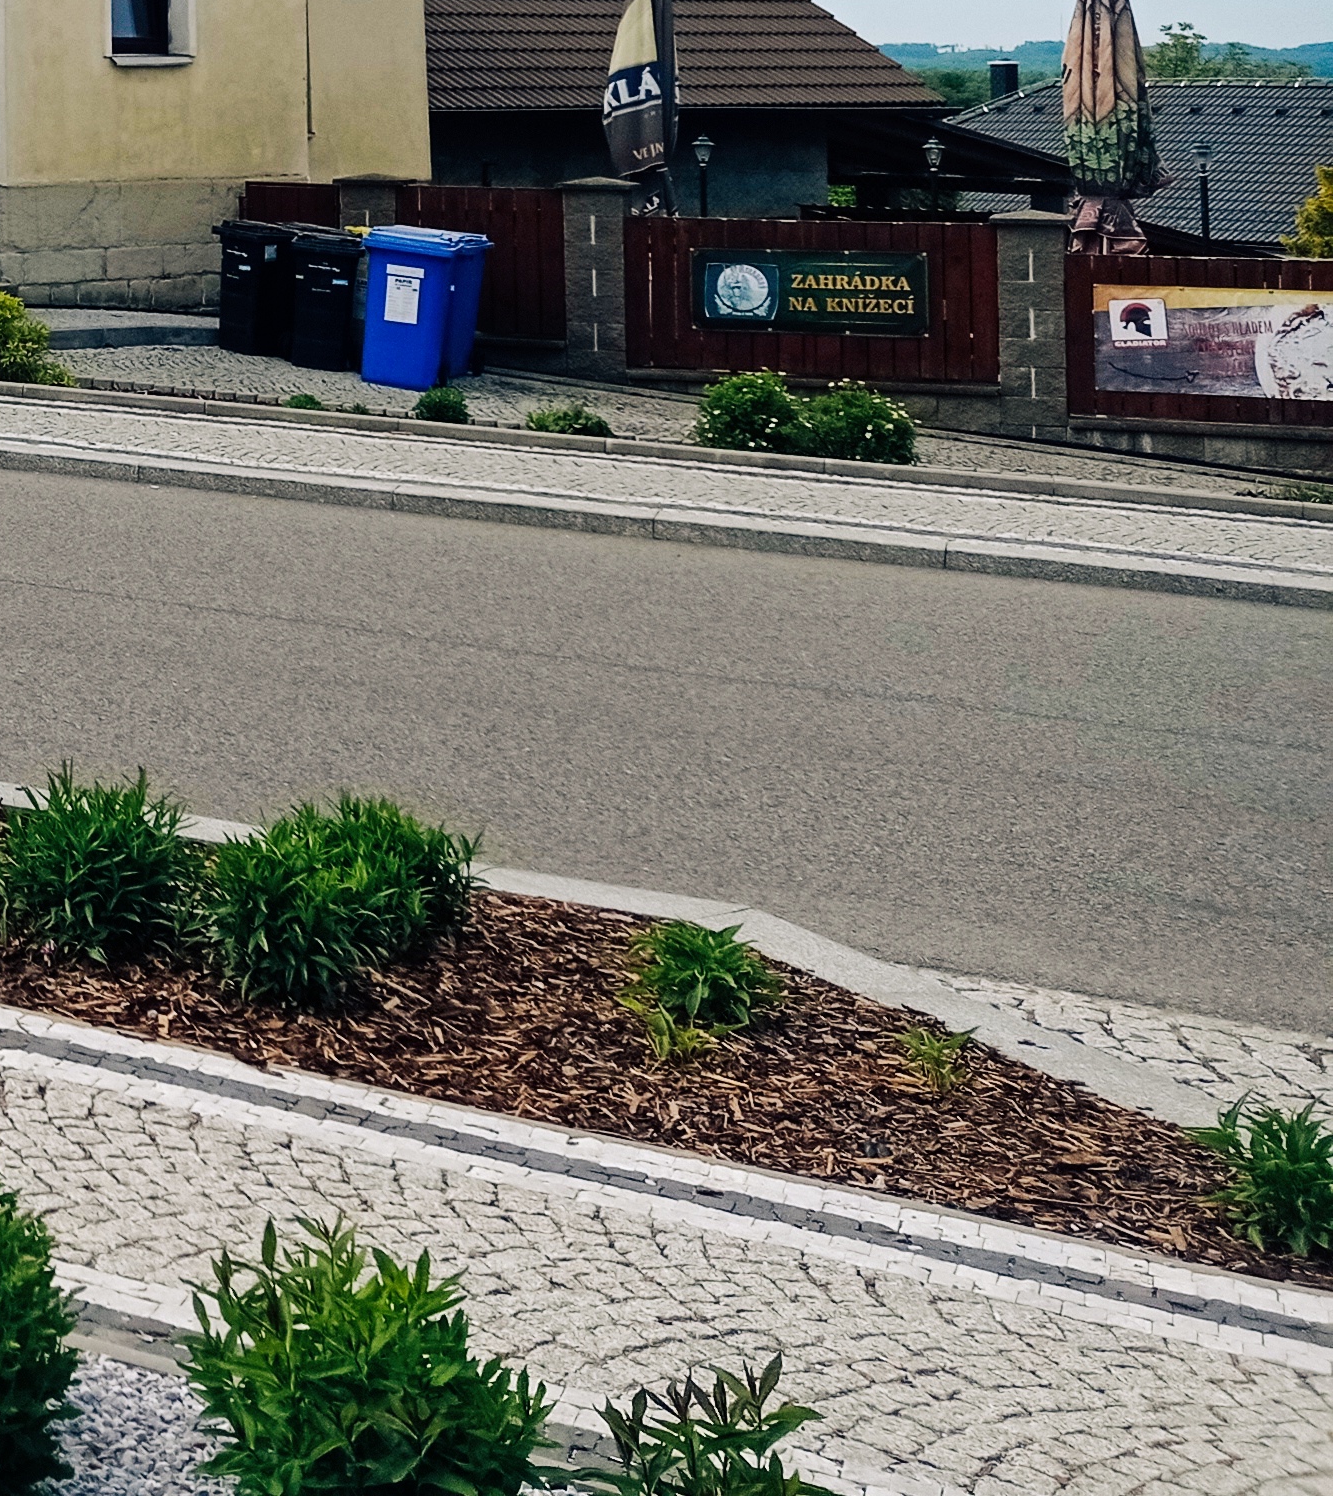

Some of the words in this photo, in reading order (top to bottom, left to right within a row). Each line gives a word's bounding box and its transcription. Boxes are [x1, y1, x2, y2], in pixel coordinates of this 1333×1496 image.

[790, 271, 911, 291] ZAHRÁDKA
[789, 296, 819, 312] NA
[825, 293, 916, 315] KNÍŽECÍ
[1232, 319, 1274, 336] HLADEM
[1113, 339, 1167, 348] GLADIATOR
